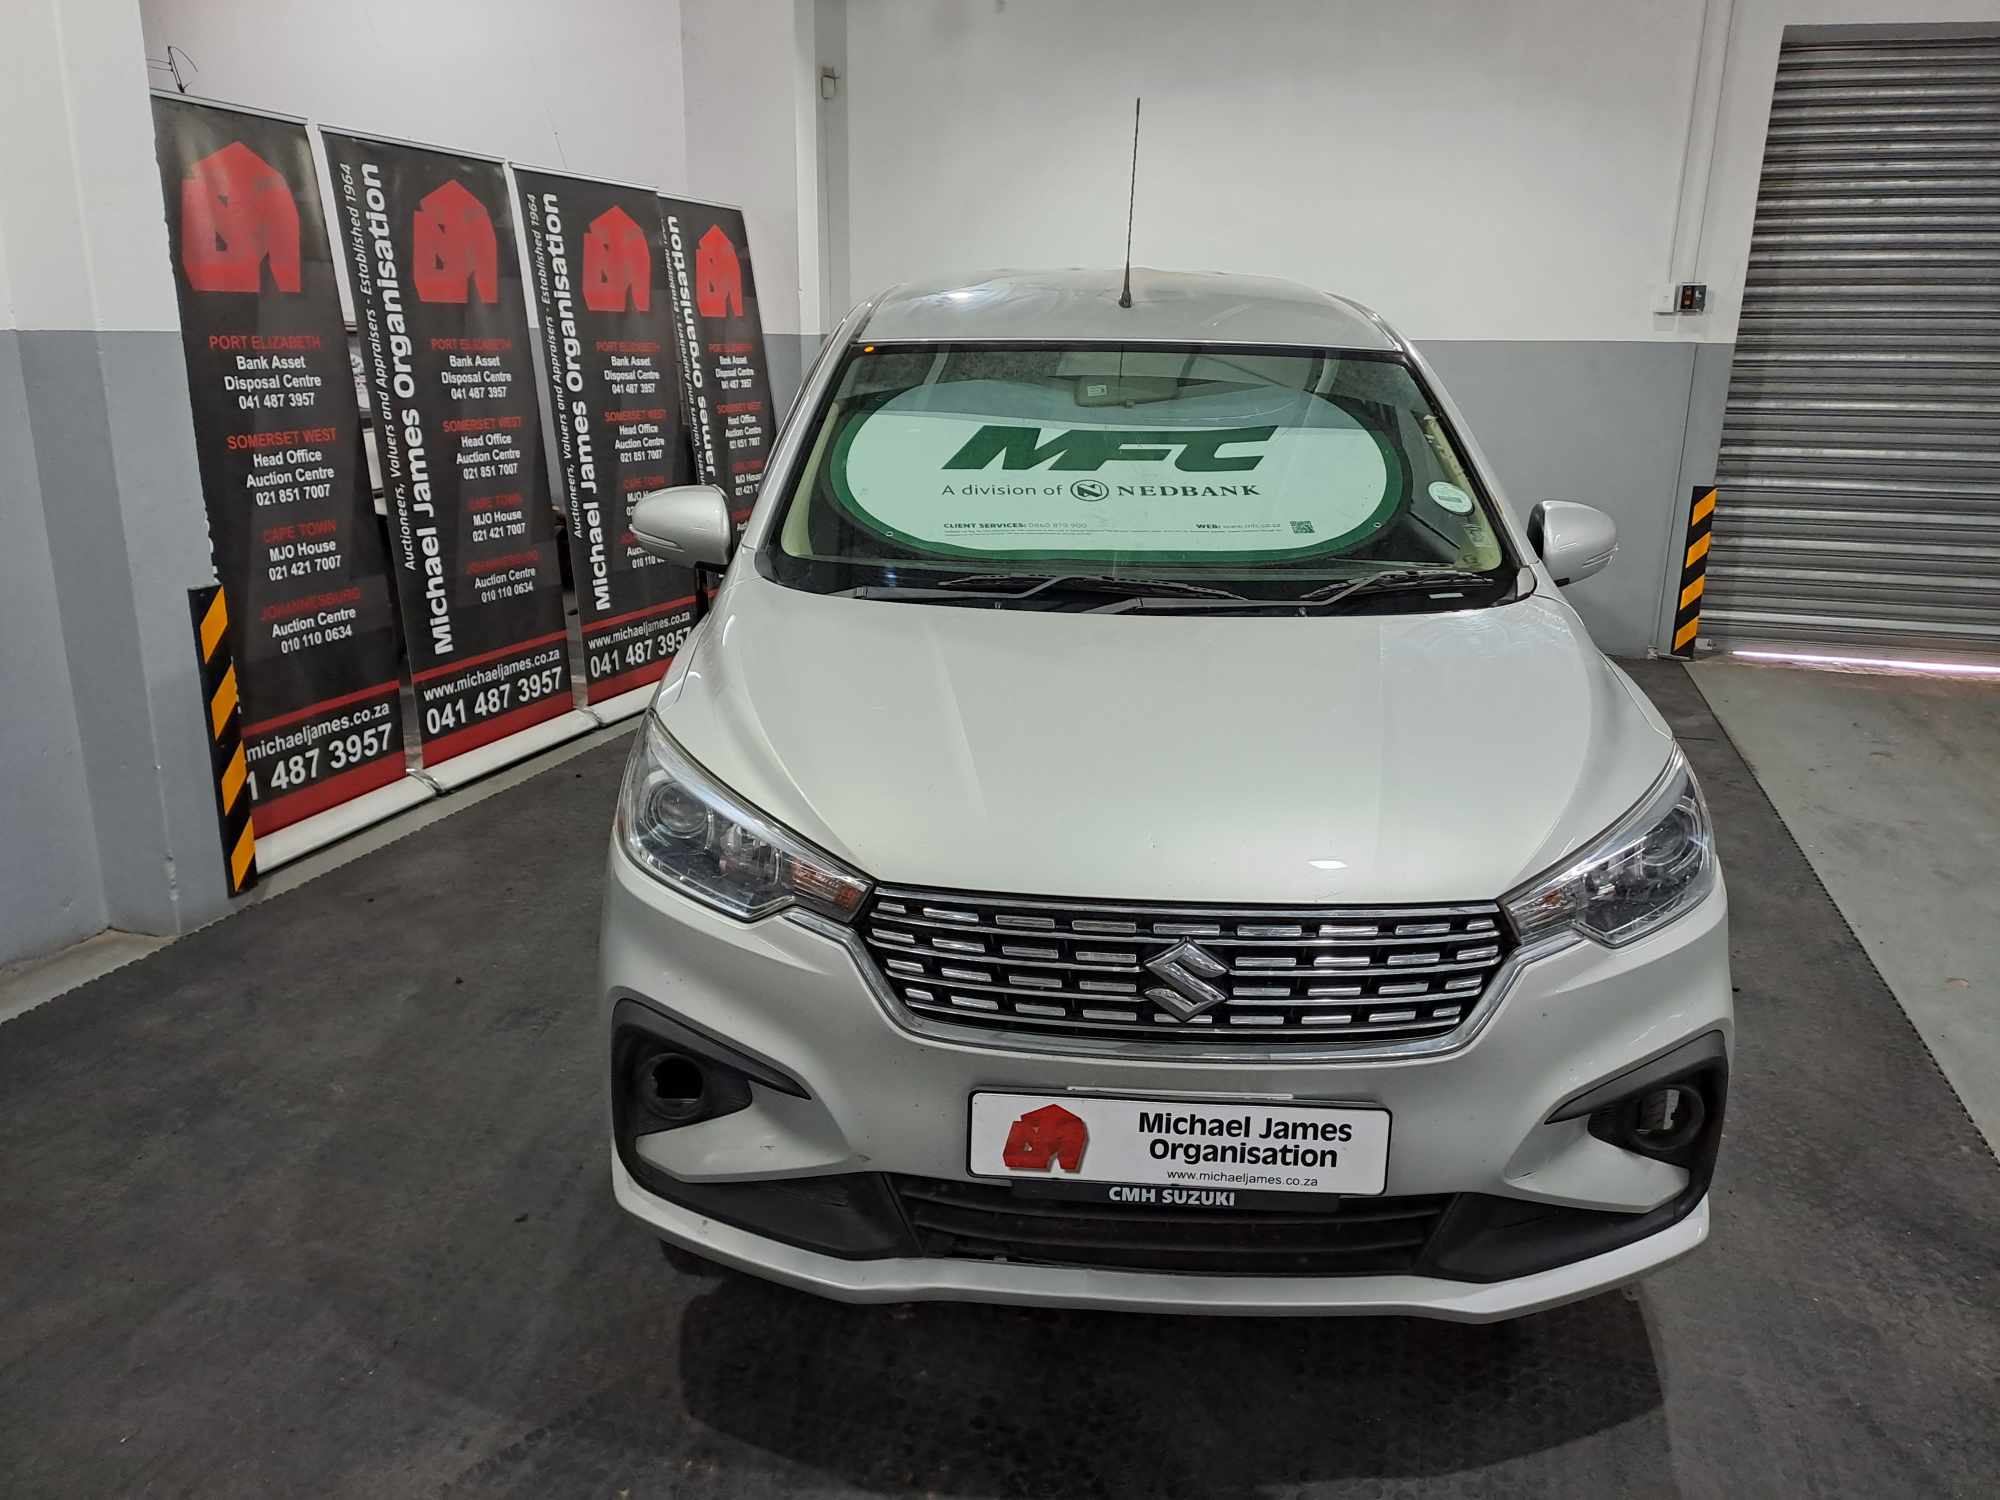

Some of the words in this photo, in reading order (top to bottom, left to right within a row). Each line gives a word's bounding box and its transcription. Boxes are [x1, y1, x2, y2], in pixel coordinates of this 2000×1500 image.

[340, 163, 357, 201] 1964
[347, 206, 372, 295] Established
[361, 163, 415, 398] Organisation
[543, 194, 583, 392] Organisation
[667, 215, 703, 388] Organisation
[209, 336, 247, 350] PORT
[366, 308, 388, 388] Appraisers
[236, 355, 269, 370] Bank
[272, 355, 306, 369] Asset
[449, 355, 473, 367] Bank
[475, 355, 500, 367] Asset
[611, 356, 630, 366] Bank
[224, 374, 280, 392] Disposal
[283, 374, 322, 387] Centre
[441, 371, 481, 385] Disposal
[483, 370, 512, 383] Centre
[238, 395, 260, 410] 041
[264, 393, 284, 408] 487
[288, 392, 315, 406] 3957
[377, 390, 392, 421] and
[450, 389, 467, 400] 041
[469, 387, 484, 399] 487
[488, 386, 507, 398] 3957
[554, 385, 566, 410] and
[226, 431, 299, 449] SOMERSET
[302, 427, 337, 442] WEST
[461, 436, 484, 448] Head
[485, 434, 512, 446] Office
[560, 413, 571, 459] Valuers
[572, 401, 597, 494] James
[615, 439, 641, 450] Auction
[642, 437, 665, 447] Centre
[698, 396, 715, 477] James
[941, 425, 1279, 472] MFC
[253, 452, 283, 468] Head
[287, 449, 322, 463] Office
[385, 424, 401, 478] Valuers
[402, 408, 434, 517] James
[456, 451, 490, 464] Auction
[492, 449, 520, 461] Centre
[246, 472, 292, 488] Auction
[295, 467, 335, 482] Centre
[464, 467, 479, 480] 021
[480, 465, 496, 478] 851
[499, 463, 518, 476] 7007
[255, 491, 276, 507] 021
[279, 487, 300, 503] 851
[303, 484, 331, 500] 7007
[942, 485, 956, 496] A
[962, 484, 1036, 496] division
[1043, 484, 1063, 496] of
[1116, 485, 1261, 497] NEDBANK
[473, 513, 492, 526] MJO
[494, 510, 522, 523] House
[472, 529, 487, 542] 021
[489, 527, 504, 540] 421
[507, 523, 526, 536] 7007
[269, 545, 295, 562] MJO
[297, 540, 336, 556] House
[583, 502, 610, 611] Michael
[269, 566, 288, 581] 021
[291, 561, 311, 577] 421
[315, 555, 342, 571] 7007
[474, 574, 506, 589] Auction
[509, 567, 536, 581] Centre
[416, 527, 453, 656] Michael
[481, 589, 496, 603] 010
[498, 586, 512, 600] 110
[515, 581, 533, 597] 0634
[272, 618, 315, 638] Auction
[317, 607, 356, 626] Centre
[588, 611, 690, 650] www.michaeljames.co.za
[281, 636, 300, 654] 010
[302, 631, 322, 648] 110
[325, 623, 352, 642] 0634
[590, 649, 620, 678] 041
[625, 639, 653, 666] 487
[424, 649, 560, 701] www.michaeljames.co.za
[426, 699, 467, 735] 041
[474, 683, 511, 717] 487
[517, 666, 562, 702] 3957
[247, 702, 390, 762] michaeljames.co.za
[271, 748, 319, 790] 487
[328, 723, 392, 769] 3957
[1139, 1112, 1251, 1137] Michael
[1258, 1117, 1352, 1142] James
[1150, 1139, 1338, 1167] Organisation
[1167, 1170, 1318, 1187] www.michaeljames.co.za
[1109, 1187, 1155, 1203] CMH
[1162, 1188, 1235, 1207] SUZUKI
